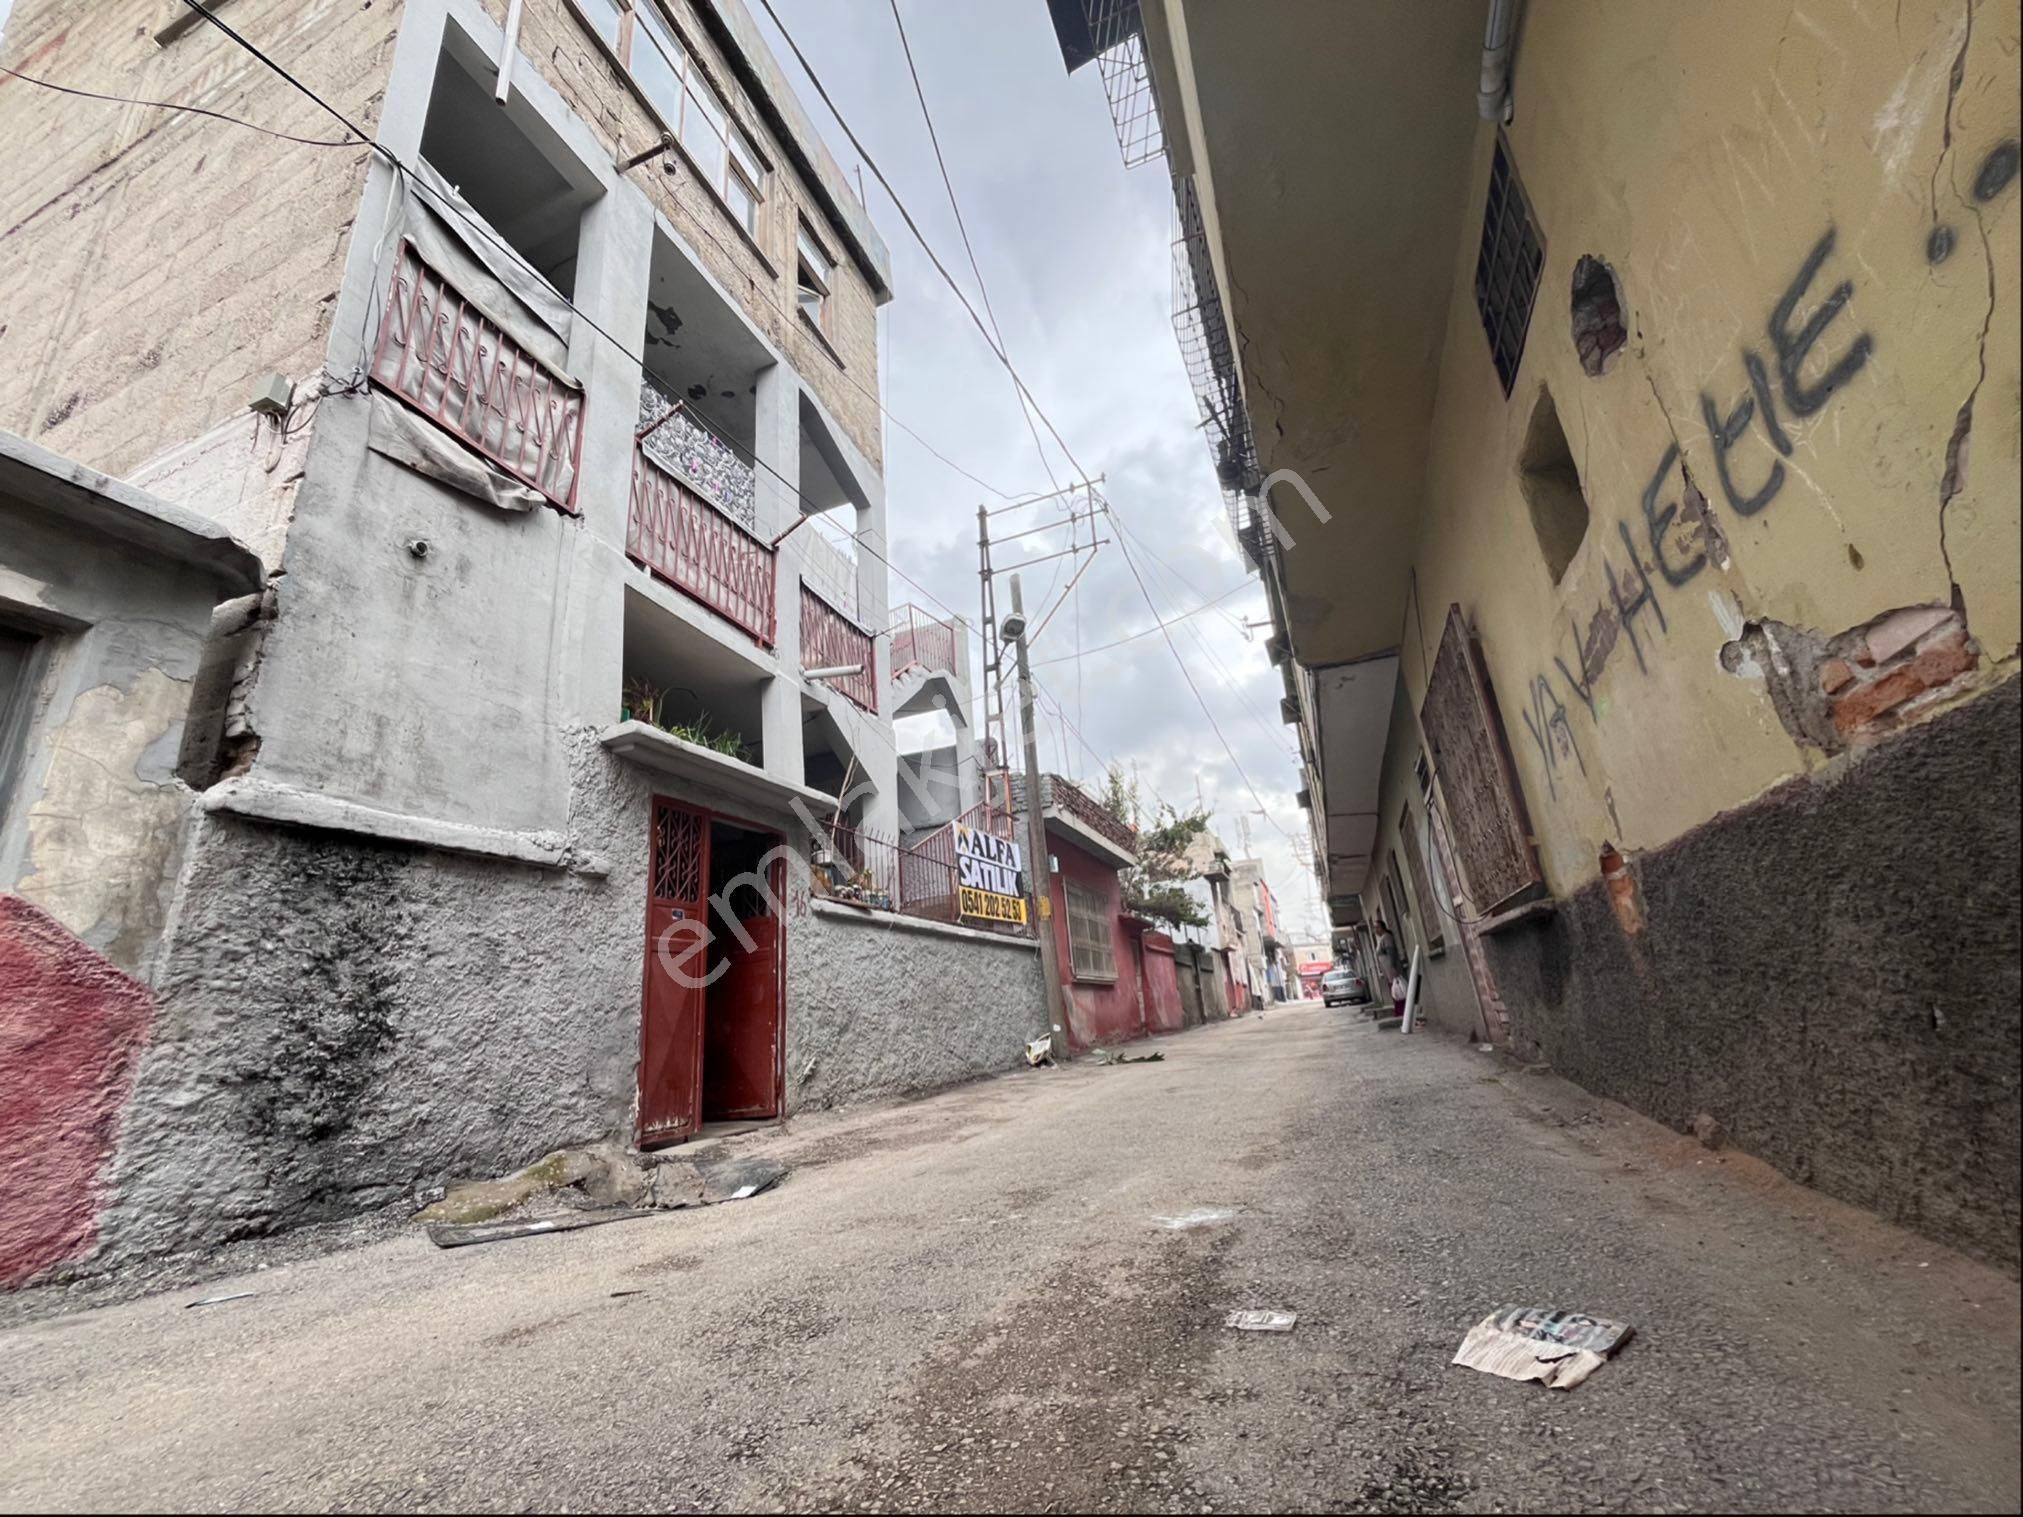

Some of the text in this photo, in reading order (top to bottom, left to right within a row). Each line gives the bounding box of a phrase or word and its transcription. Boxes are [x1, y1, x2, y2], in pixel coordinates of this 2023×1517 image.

[971, 829, 1017, 869] ALFA
[960, 856, 1020, 898] SATILIK
[961, 889, 983, 915] 0541
[985, 893, 1000, 917] 202
[1001, 897, 1012, 919] 52
